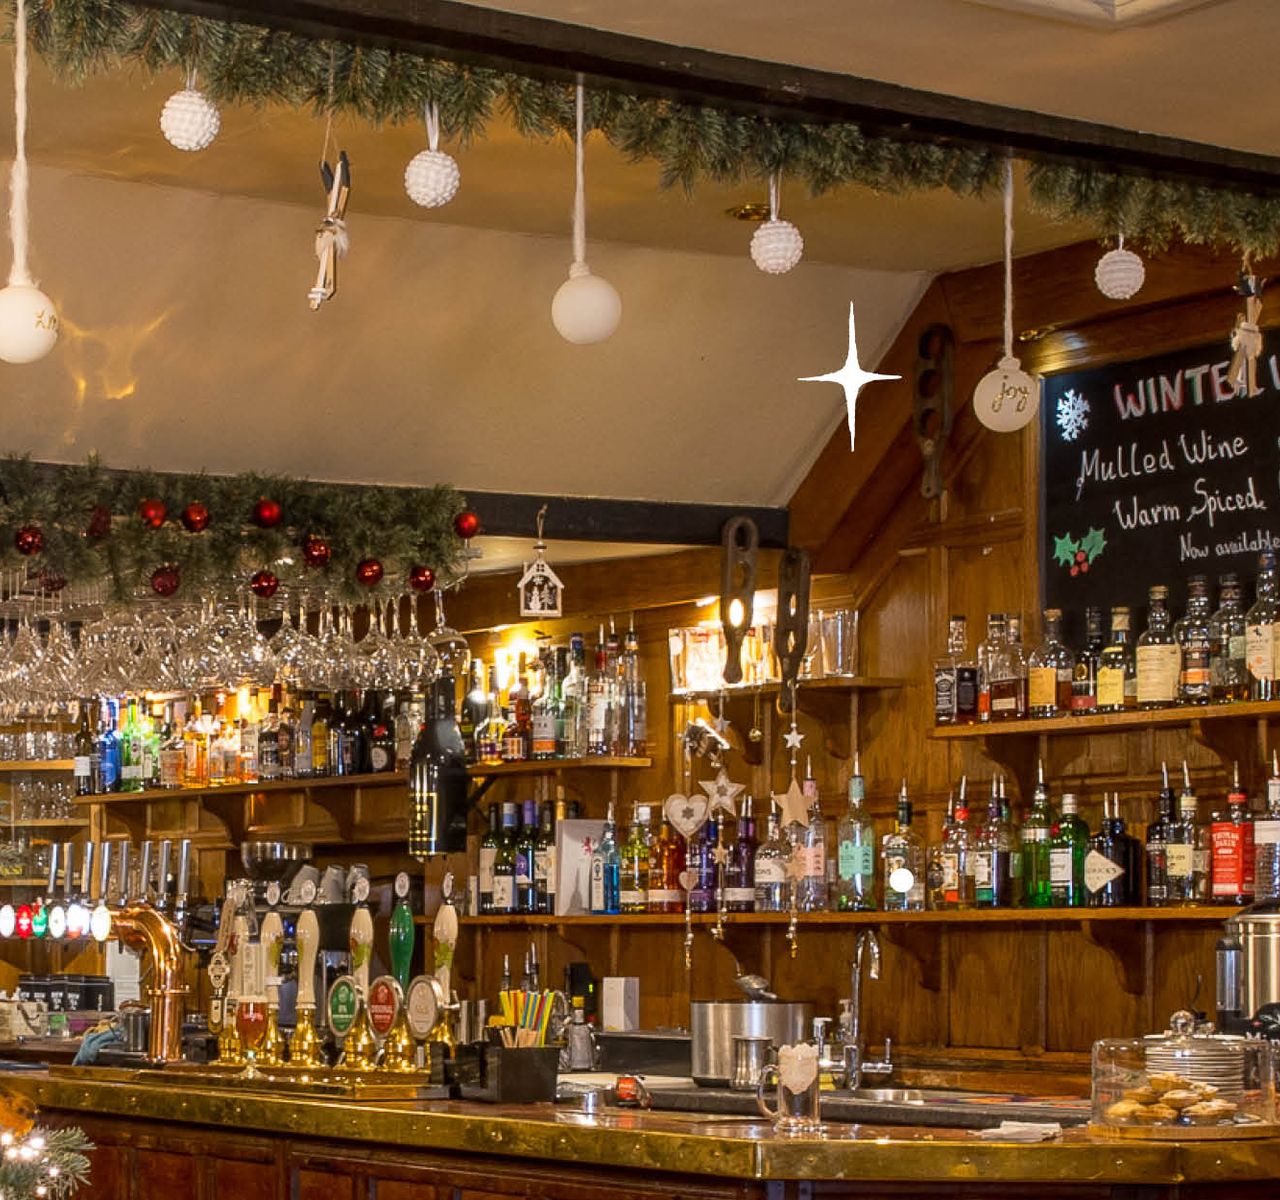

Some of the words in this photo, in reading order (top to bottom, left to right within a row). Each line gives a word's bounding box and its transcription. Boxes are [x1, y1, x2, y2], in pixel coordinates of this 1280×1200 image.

[991, 375, 1030, 413] joy
[1075, 440, 1175, 500] Mulled
[1180, 430, 1249, 465] Wine
[1113, 496, 1181, 530] Warm
[1186, 477, 1268, 528] Spiced
[1180, 534, 1210, 562] Now
